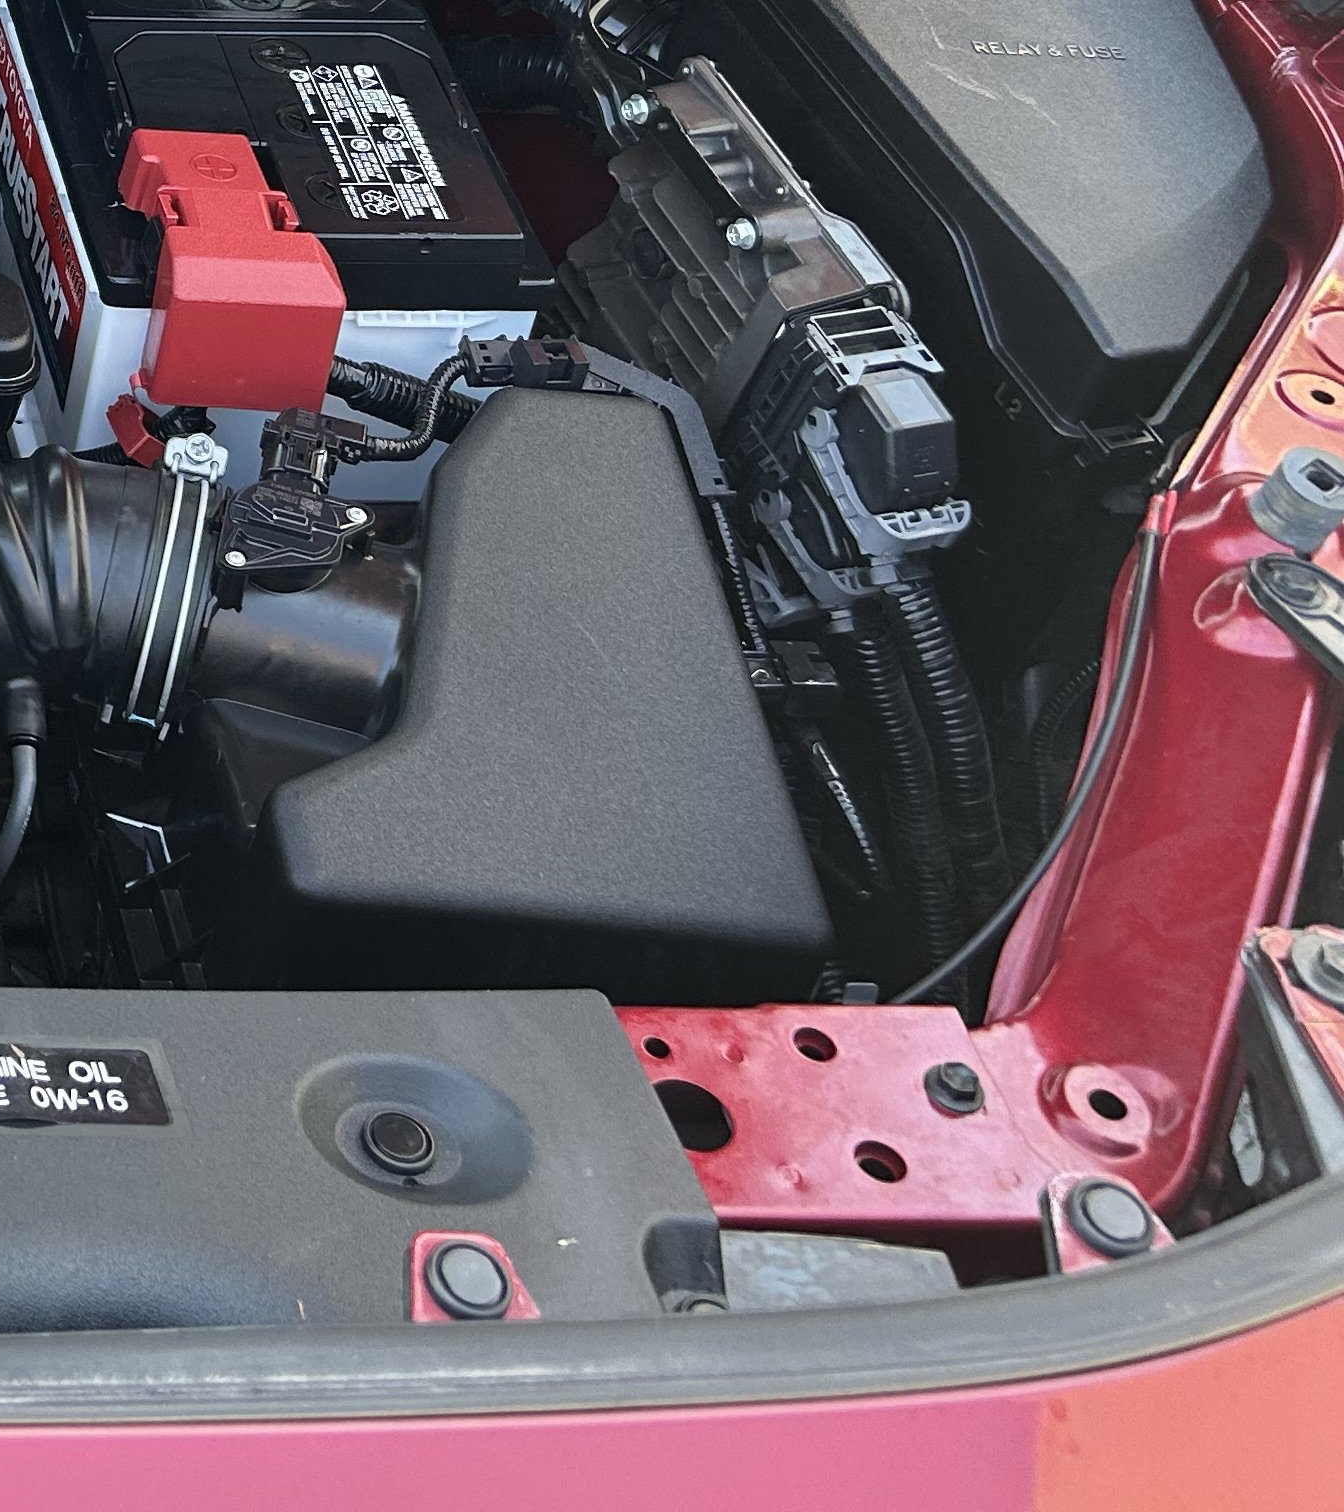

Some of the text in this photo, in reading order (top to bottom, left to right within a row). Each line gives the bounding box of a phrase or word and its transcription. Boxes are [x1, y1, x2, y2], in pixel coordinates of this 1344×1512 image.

[971, 40, 1127, 60] RELAY & FUSE
[5, 53, 33, 149] TOYOTA
[68, 1061, 122, 1084] OIL
